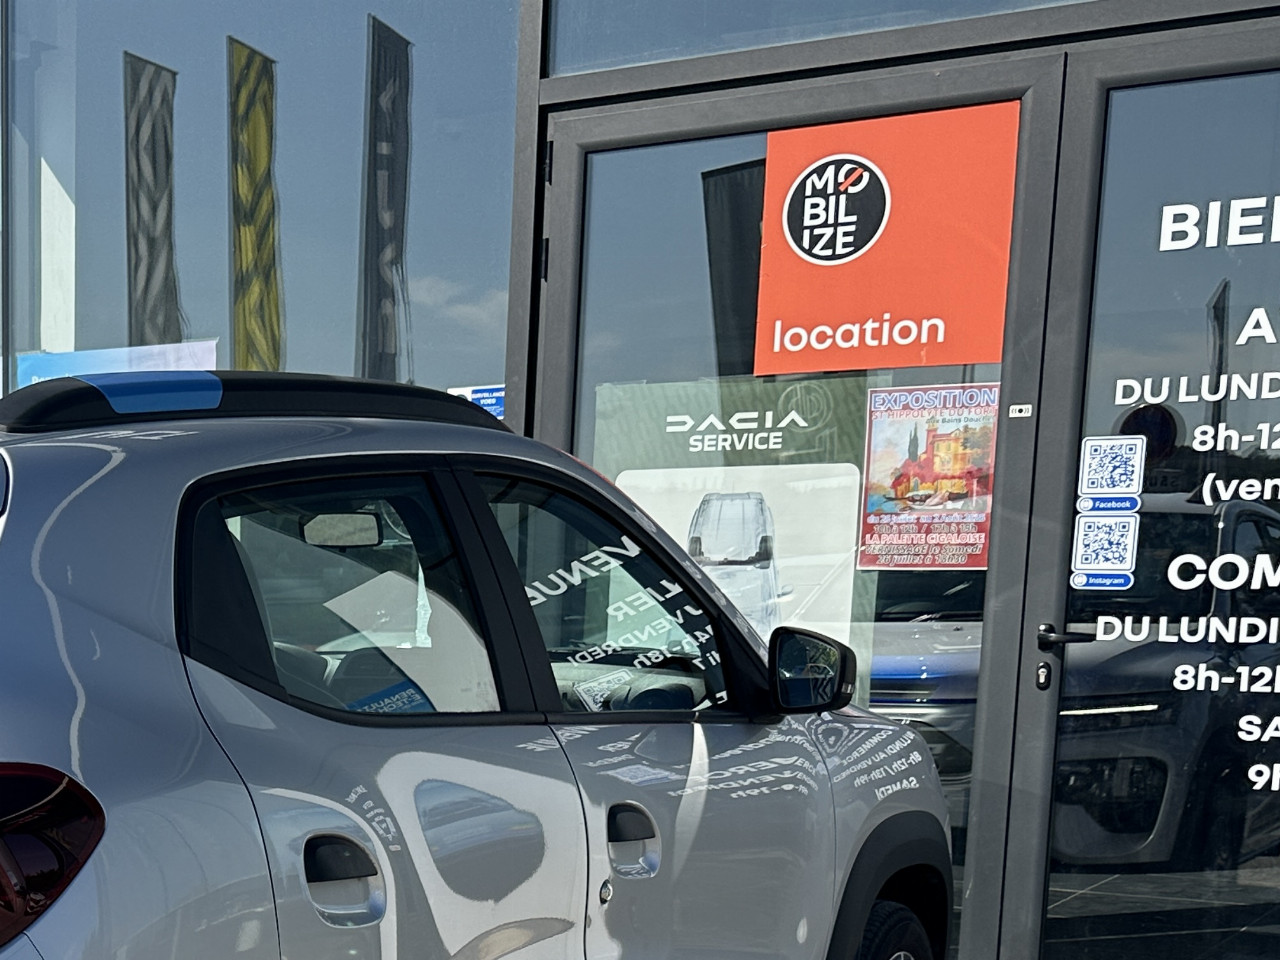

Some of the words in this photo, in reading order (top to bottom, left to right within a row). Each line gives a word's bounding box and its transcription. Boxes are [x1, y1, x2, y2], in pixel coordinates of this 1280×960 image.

[803, 194, 857, 227] BIL
[1159, 195, 1280, 251] BIE
[802, 225, 856, 256] IZE
[773, 312, 945, 353] location
[871, 388, 999, 411] EXPOSITION
[1114, 377, 1170, 405] DU
[666, 410, 808, 432] DACIA
[887, 407, 945, 419] HIPPOLYTE
[948, 407, 964, 417] DU
[689, 432, 783, 452] SERVICE
[1094, 500, 1131, 509] Facebook
[865, 534, 879, 544] LA
[881, 533, 926, 544] PALETTE
[927, 532, 985, 543] CIGALOISE
[865, 544, 928, 555] VERNISSAGE
[1088, 576, 1124, 586] Instagram
[1096, 616, 1151, 642] DU
[1158, 616, 1280, 644] LUNDI
[1173, 663, 1280, 693] 8h-12
